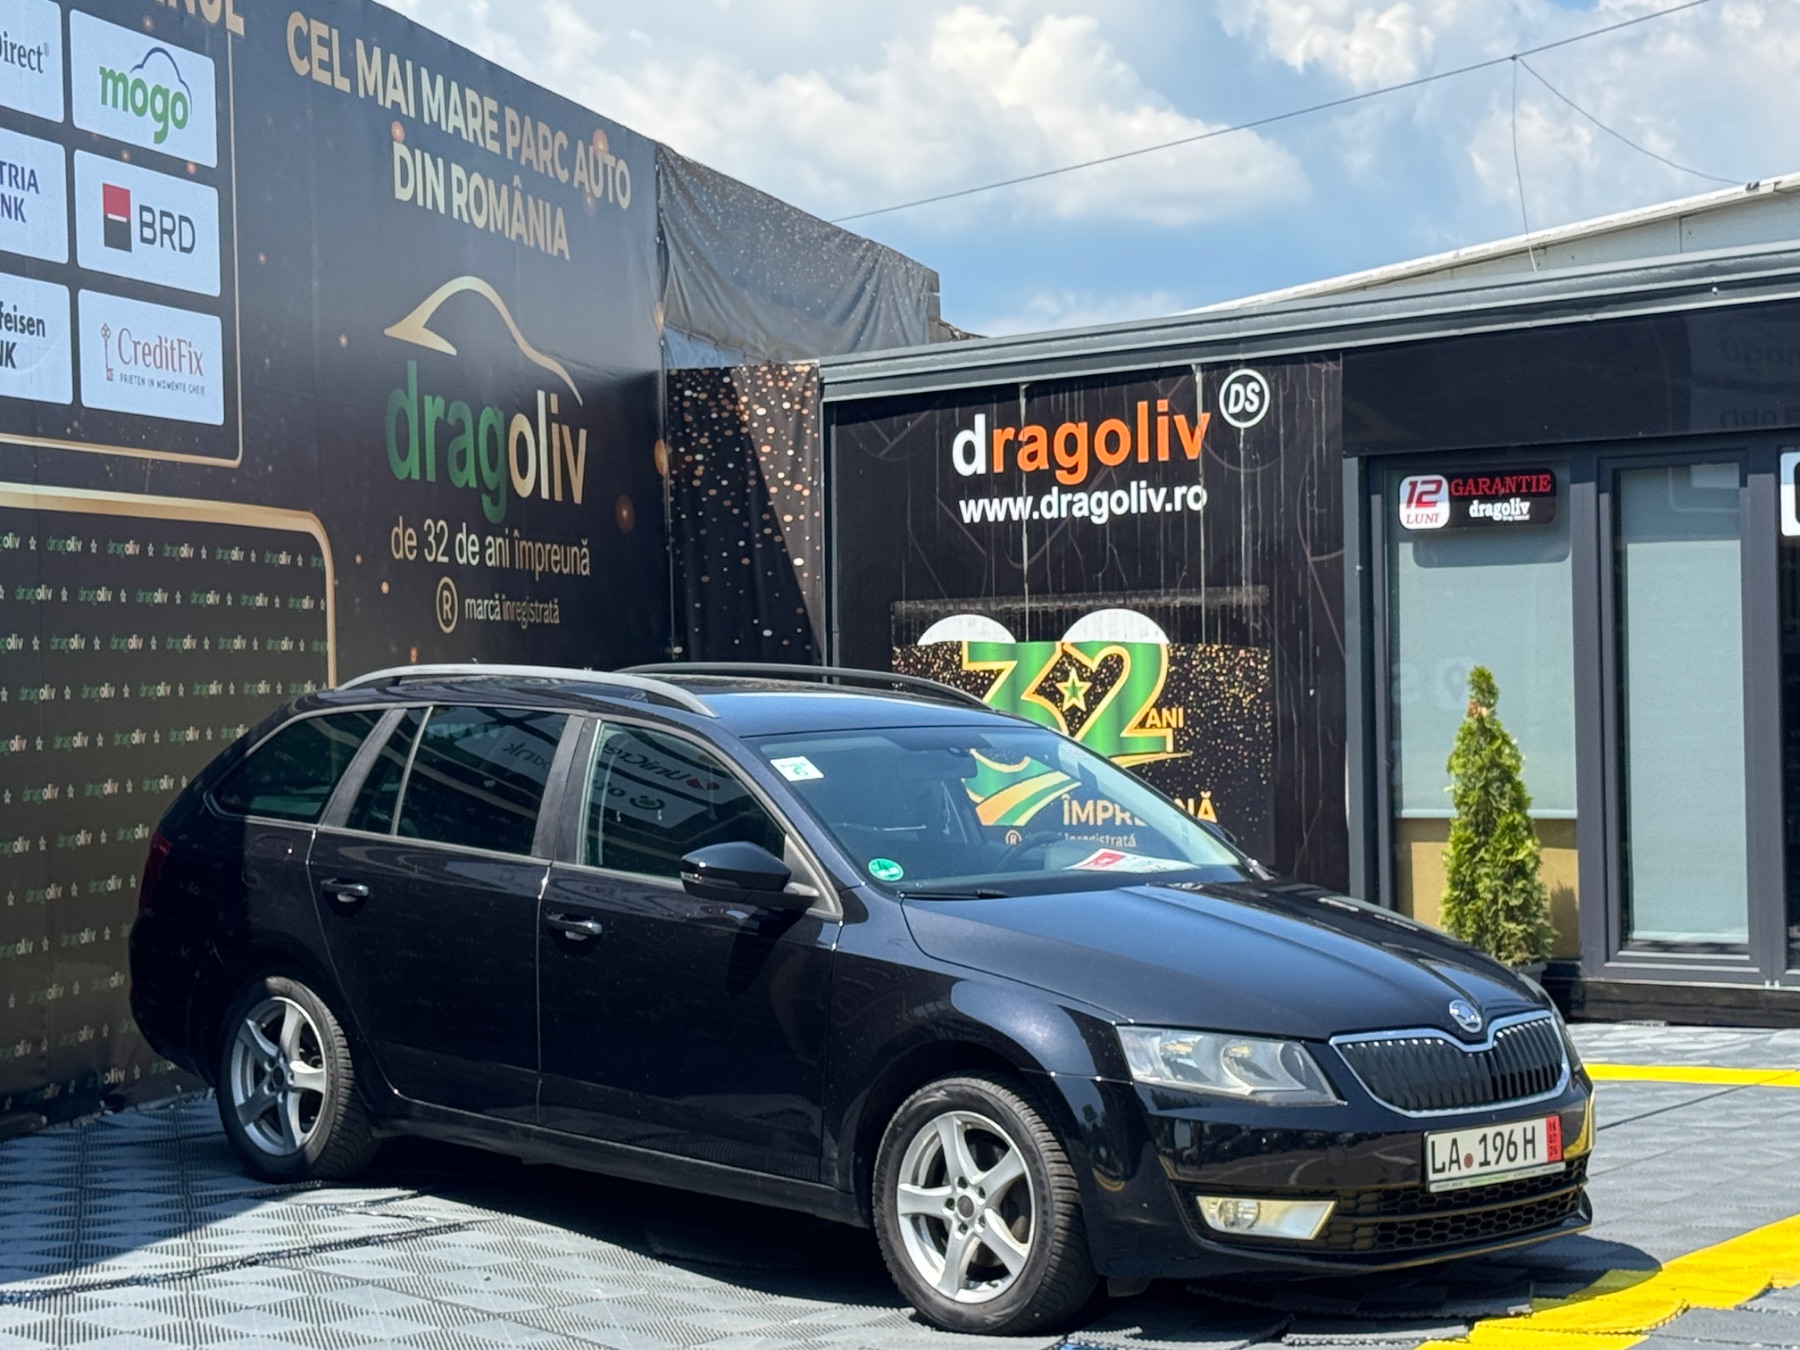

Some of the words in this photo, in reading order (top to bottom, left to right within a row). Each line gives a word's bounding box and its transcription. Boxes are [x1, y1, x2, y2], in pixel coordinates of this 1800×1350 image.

[99, 65, 189, 144] mogo
[286, 11, 350, 93] CEL
[355, 38, 416, 118] MAI
[420, 67, 500, 155] MARE
[504, 105, 569, 184] PARC
[573, 139, 632, 210] AUTO
[392, 140, 445, 215] DIN
[451, 163, 570, 261] ROMÂNIA
[139, 204, 196, 254] BRD
[117, 327, 204, 377] CreditFix
[1227, 381, 1261, 414] DS
[386, 359, 588, 524] dragoliv
[952, 399, 1211, 486] dragoliv
[958, 480, 1208, 525] www.dragoliv.ro
[1406, 479, 1443, 509] 12
[1451, 474, 1552, 496] GARANTIE
[1406, 513, 1440, 525] LUNI
[1468, 497, 1531, 521] dragoliv
[391, 515, 417, 561] de
[423, 518, 449, 563] 32
[455, 522, 479, 566] de
[485, 527, 510, 569] ani
[514, 530, 590, 582] împreună
[465, 594, 501, 621] marcă
[917, 608, 1173, 760] 32
[1146, 708, 1184, 729] ANI
[1431, 1138, 1462, 1175] LA
